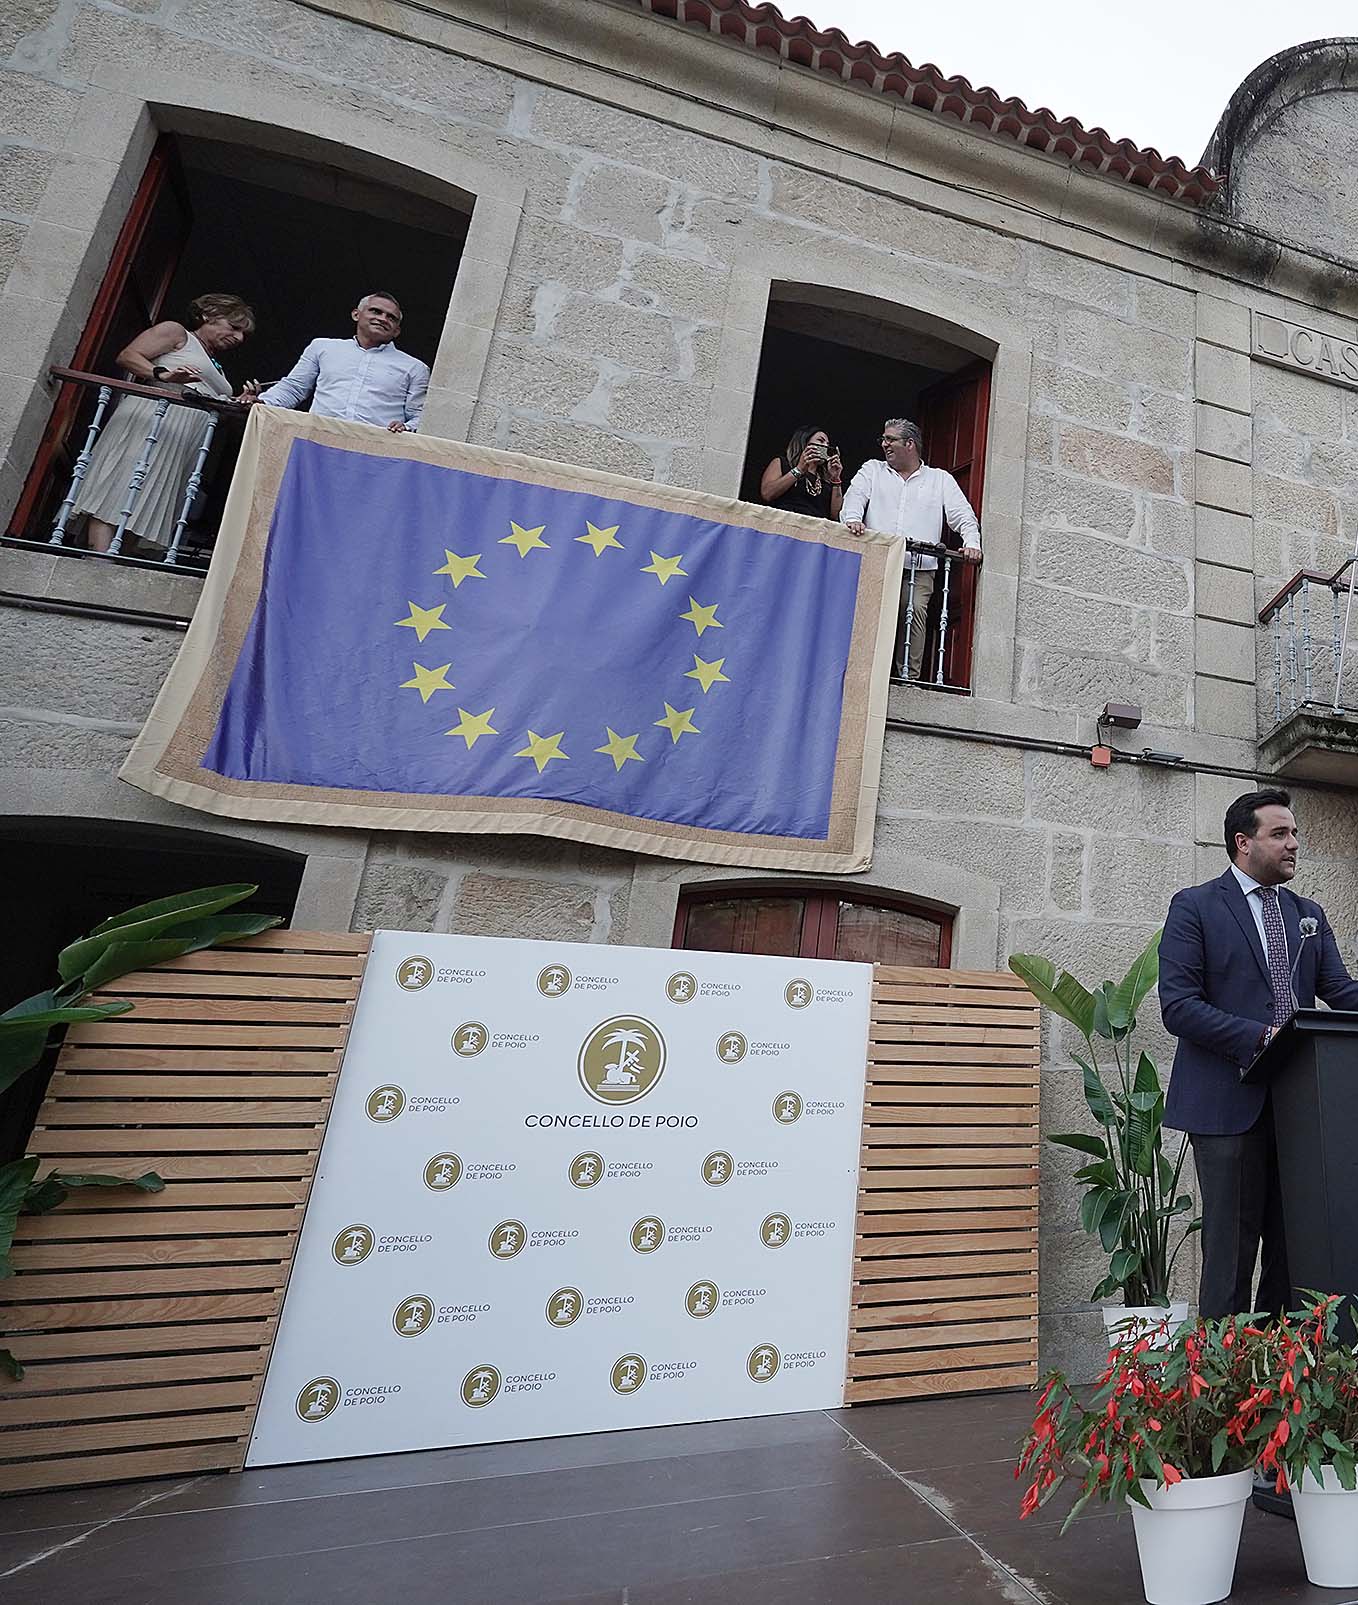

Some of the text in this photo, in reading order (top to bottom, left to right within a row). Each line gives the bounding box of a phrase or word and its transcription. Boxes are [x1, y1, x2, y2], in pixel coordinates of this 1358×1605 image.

[439, 968, 486, 976] CONCELLO
[576, 976, 619, 984] CONCELLO
[817, 989, 853, 997] CONCELLO
[524, 1114, 699, 1128] CONCELLO DE POIO
[609, 1161, 653, 1169] CONCELLO
[738, 1160, 778, 1168] CONCELLO
[531, 1230, 579, 1238] CONCELLO
[668, 1225, 712, 1234] CONCELLO
[380, 1235, 432, 1243] CONCELLO
[393, 1244, 417, 1252] POIO
[723, 1289, 766, 1297] CONCELLO
[587, 1296, 634, 1305] CONCELLO
[439, 1304, 490, 1314] CONCELLO
[600, 1305, 622, 1313] POIO
[438, 1314, 476, 1323] DE POIO
[784, 1351, 826, 1360] CONCELLO
[651, 1362, 696, 1371] CONCELLO
[795, 1360, 815, 1368] POIO
[506, 1373, 556, 1383] CONCELLO
[662, 1371, 684, 1380] POIO
[346, 1385, 401, 1396] CONCELLO
[519, 1381, 542, 1391] POIO
[344, 1396, 385, 1406] DE POIO
